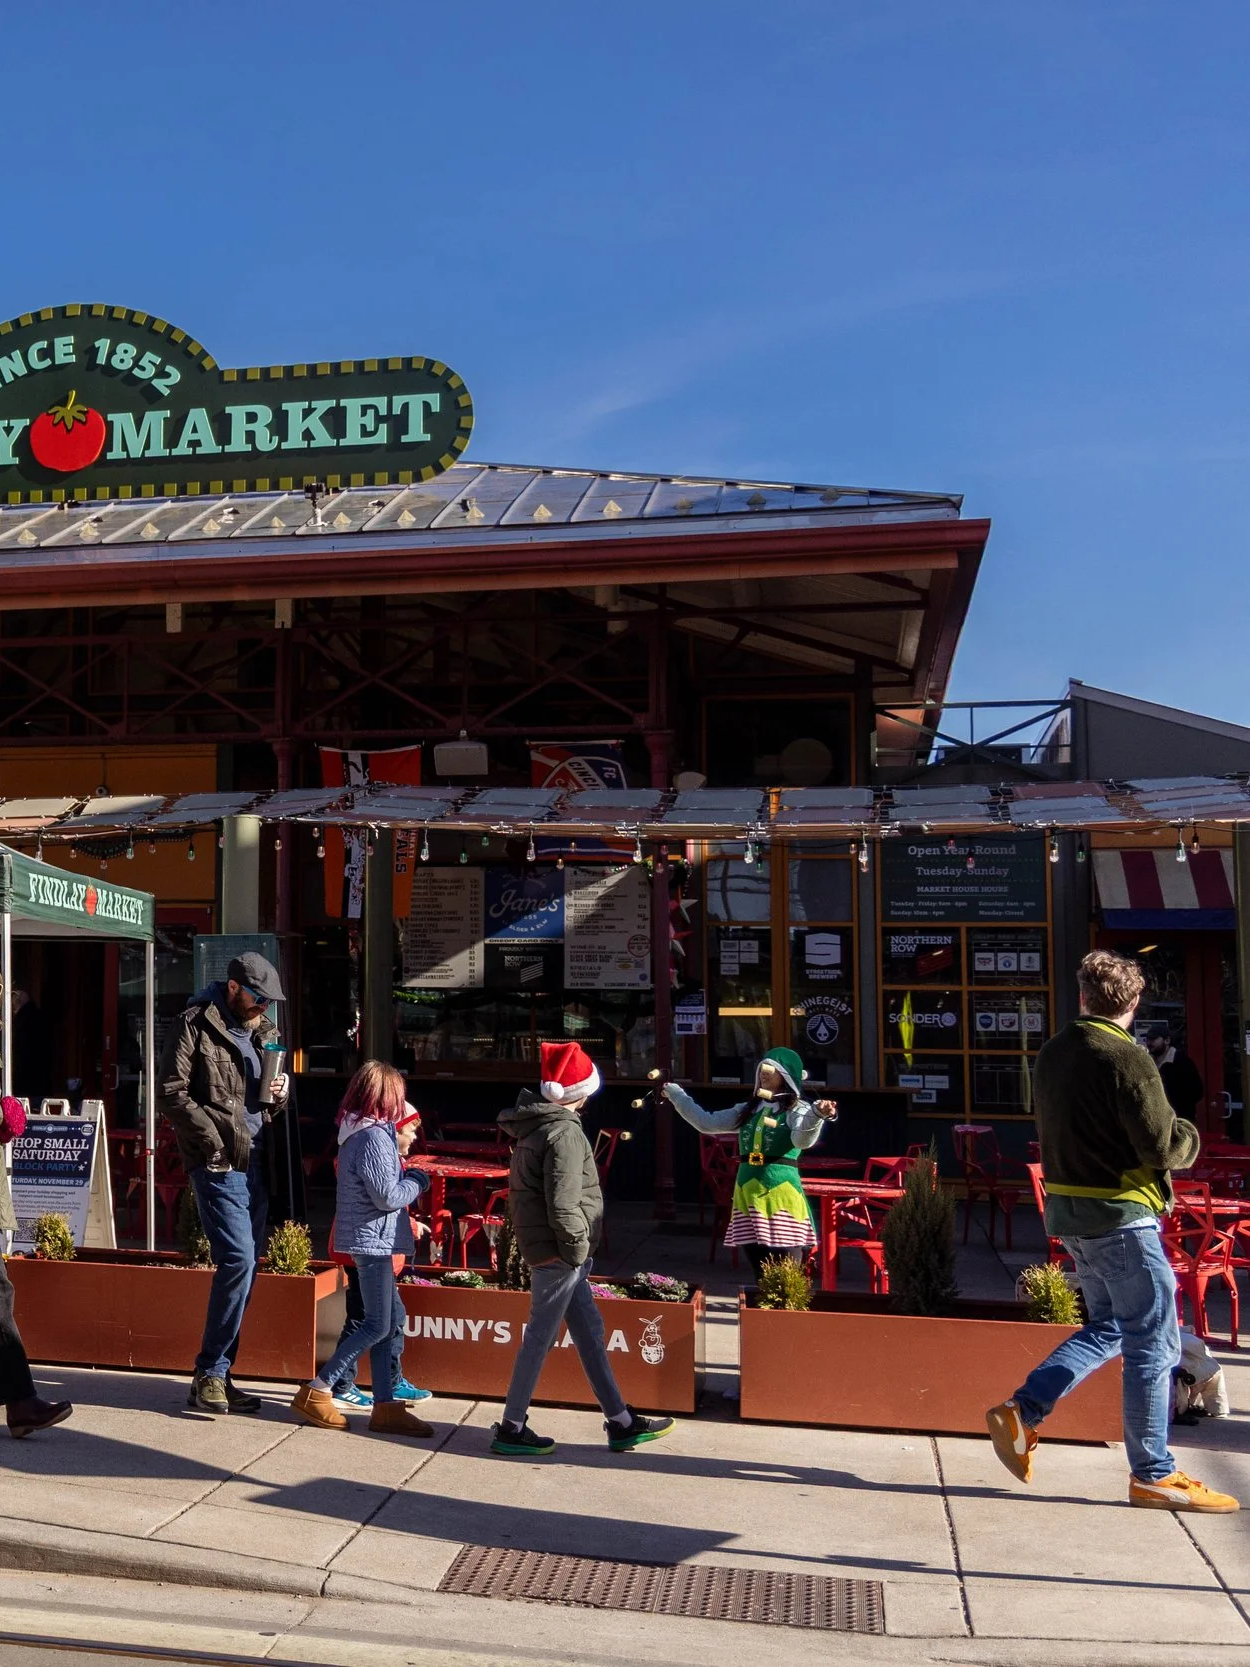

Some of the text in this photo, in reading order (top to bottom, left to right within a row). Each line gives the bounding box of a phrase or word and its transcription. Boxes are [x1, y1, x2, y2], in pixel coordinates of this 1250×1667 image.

[93, 336, 182, 397] 1852
[106, 391, 440, 460] MARKET
[602, 767, 616, 779] FC
[908, 844, 1017, 858] Open Year-Round
[915, 866, 1010, 878] Tuesday-Sunday
[916, 886, 1009, 894] MARKET HOUSE HOURS
[28, 872, 144, 925] FINDLAY MARKET
[489, 889, 560, 918] Jane's
[890, 936, 952, 944] NORTHERN
[890, 944, 917, 952] ROW
[797, 996, 853, 1016] HINEGEIST
[11, 1137, 89, 1150] SHOP SMALL
[12, 1150, 81, 1161] SATURDAY
[14, 1162, 77, 1172] BLOCK PARTY
[11, 1177, 37, 1185] TURDAY,
[38, 1178, 74, 1186] NOVEMBER
[404, 1315, 512, 1344] UNNY'S
